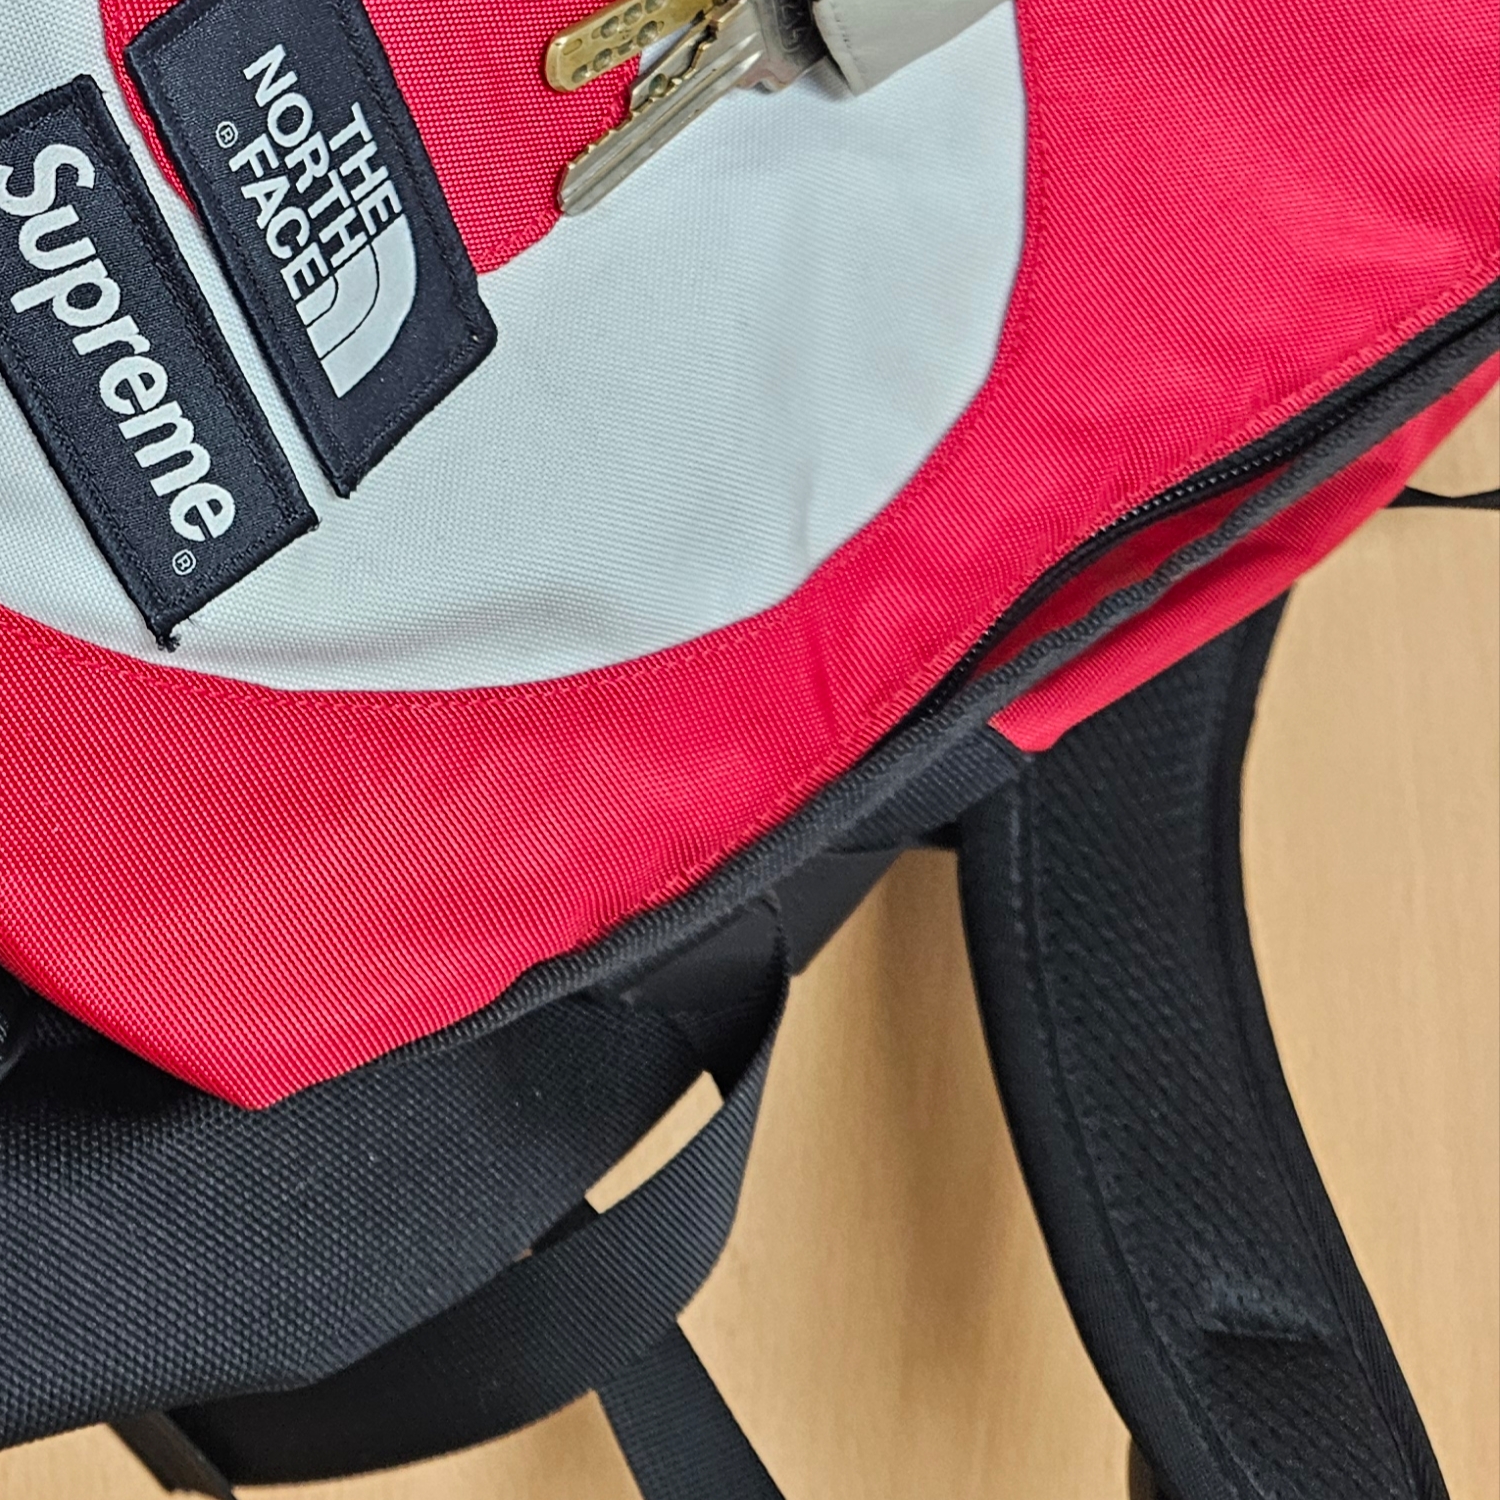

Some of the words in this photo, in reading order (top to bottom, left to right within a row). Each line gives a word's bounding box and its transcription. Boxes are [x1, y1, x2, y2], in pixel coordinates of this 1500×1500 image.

[228, 133, 329, 300] FACE
[242, 43, 368, 268] NORTH
[329, 102, 402, 235] THE
